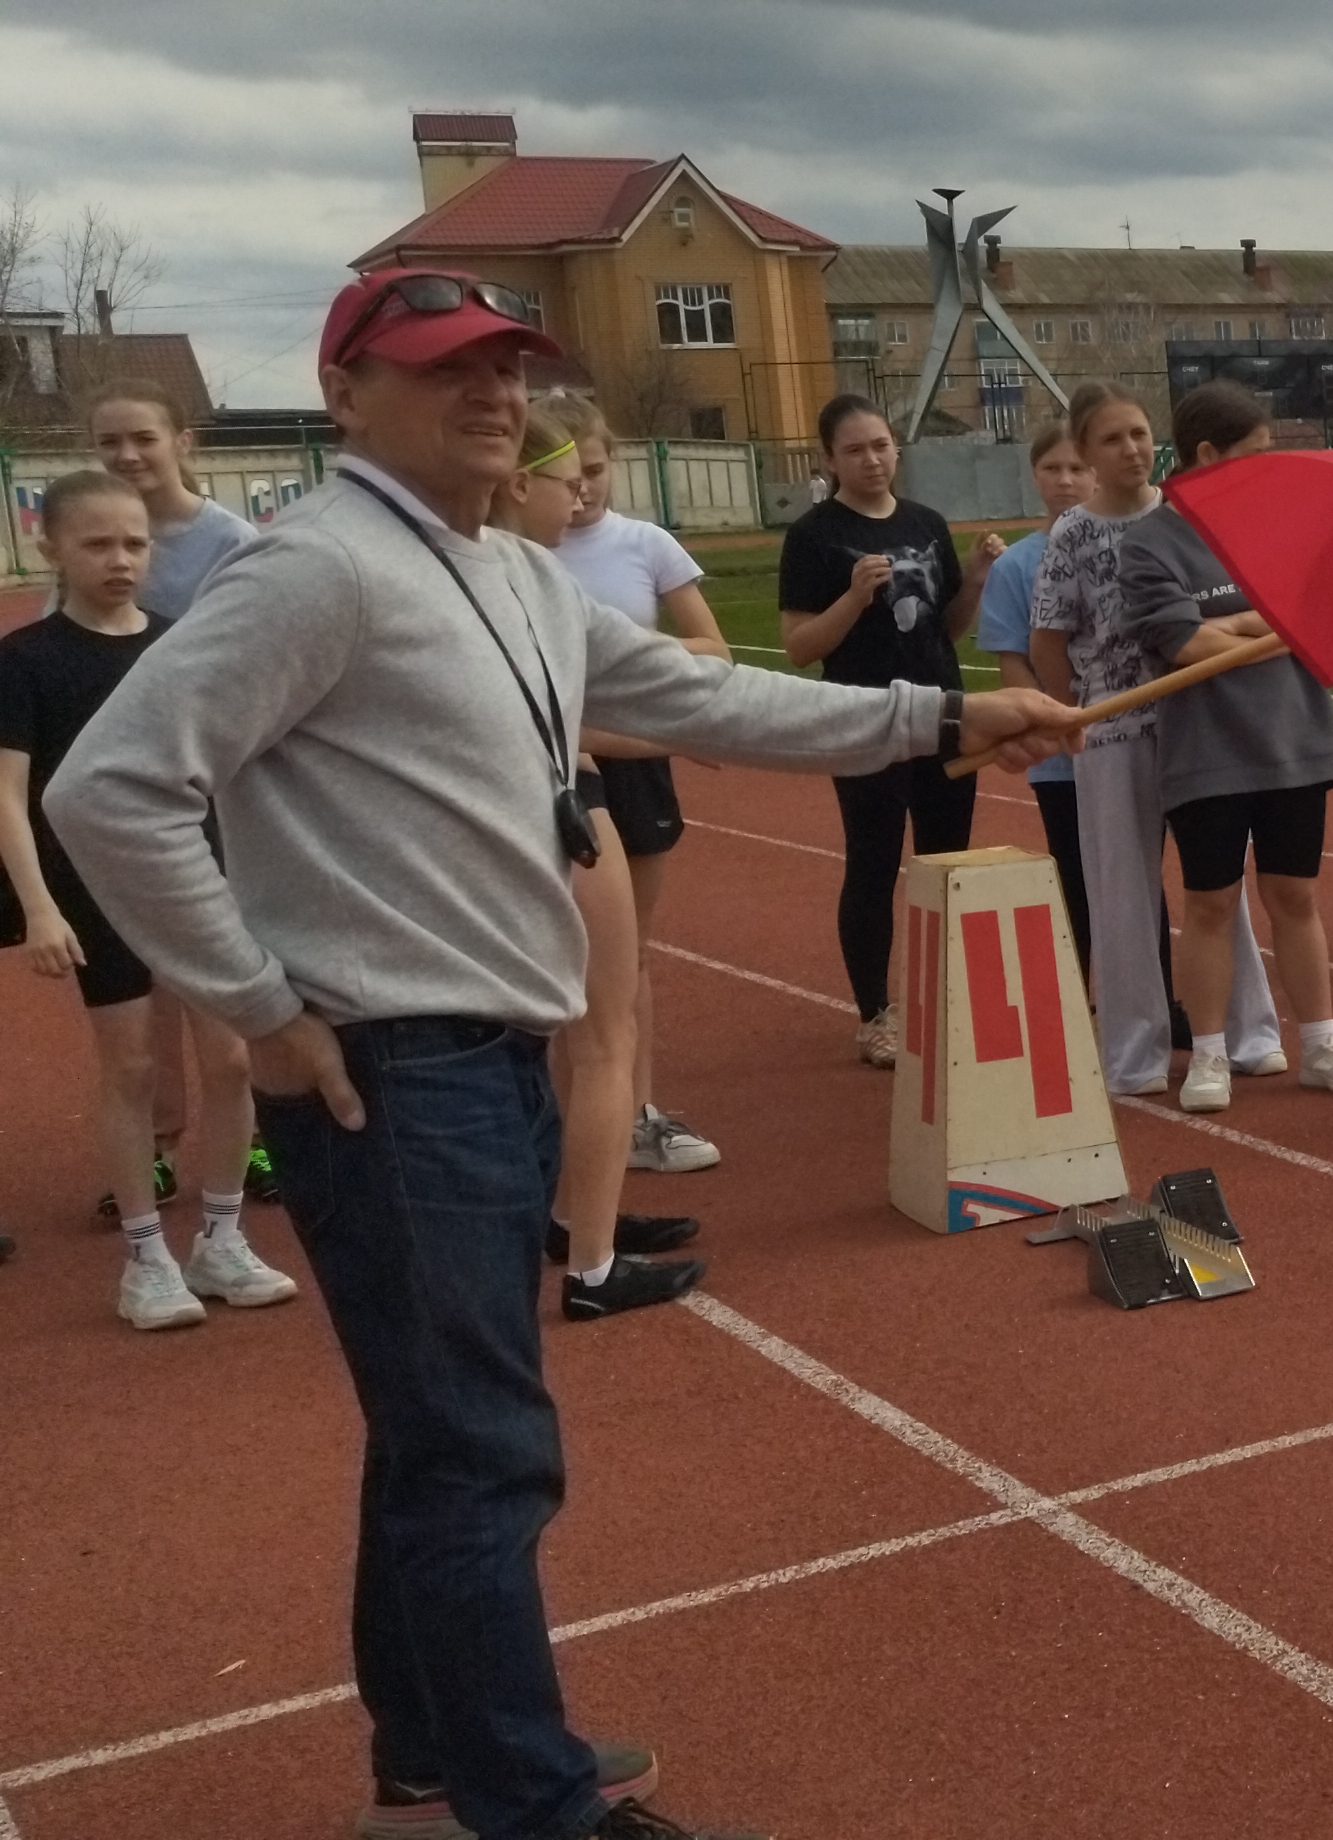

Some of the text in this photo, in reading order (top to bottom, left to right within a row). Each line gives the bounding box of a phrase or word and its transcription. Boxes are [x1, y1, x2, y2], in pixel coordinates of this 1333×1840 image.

[1190, 583, 1236, 600] RS ARE
[906, 904, 941, 1126] 4
[960, 903, 1073, 1119] 4
